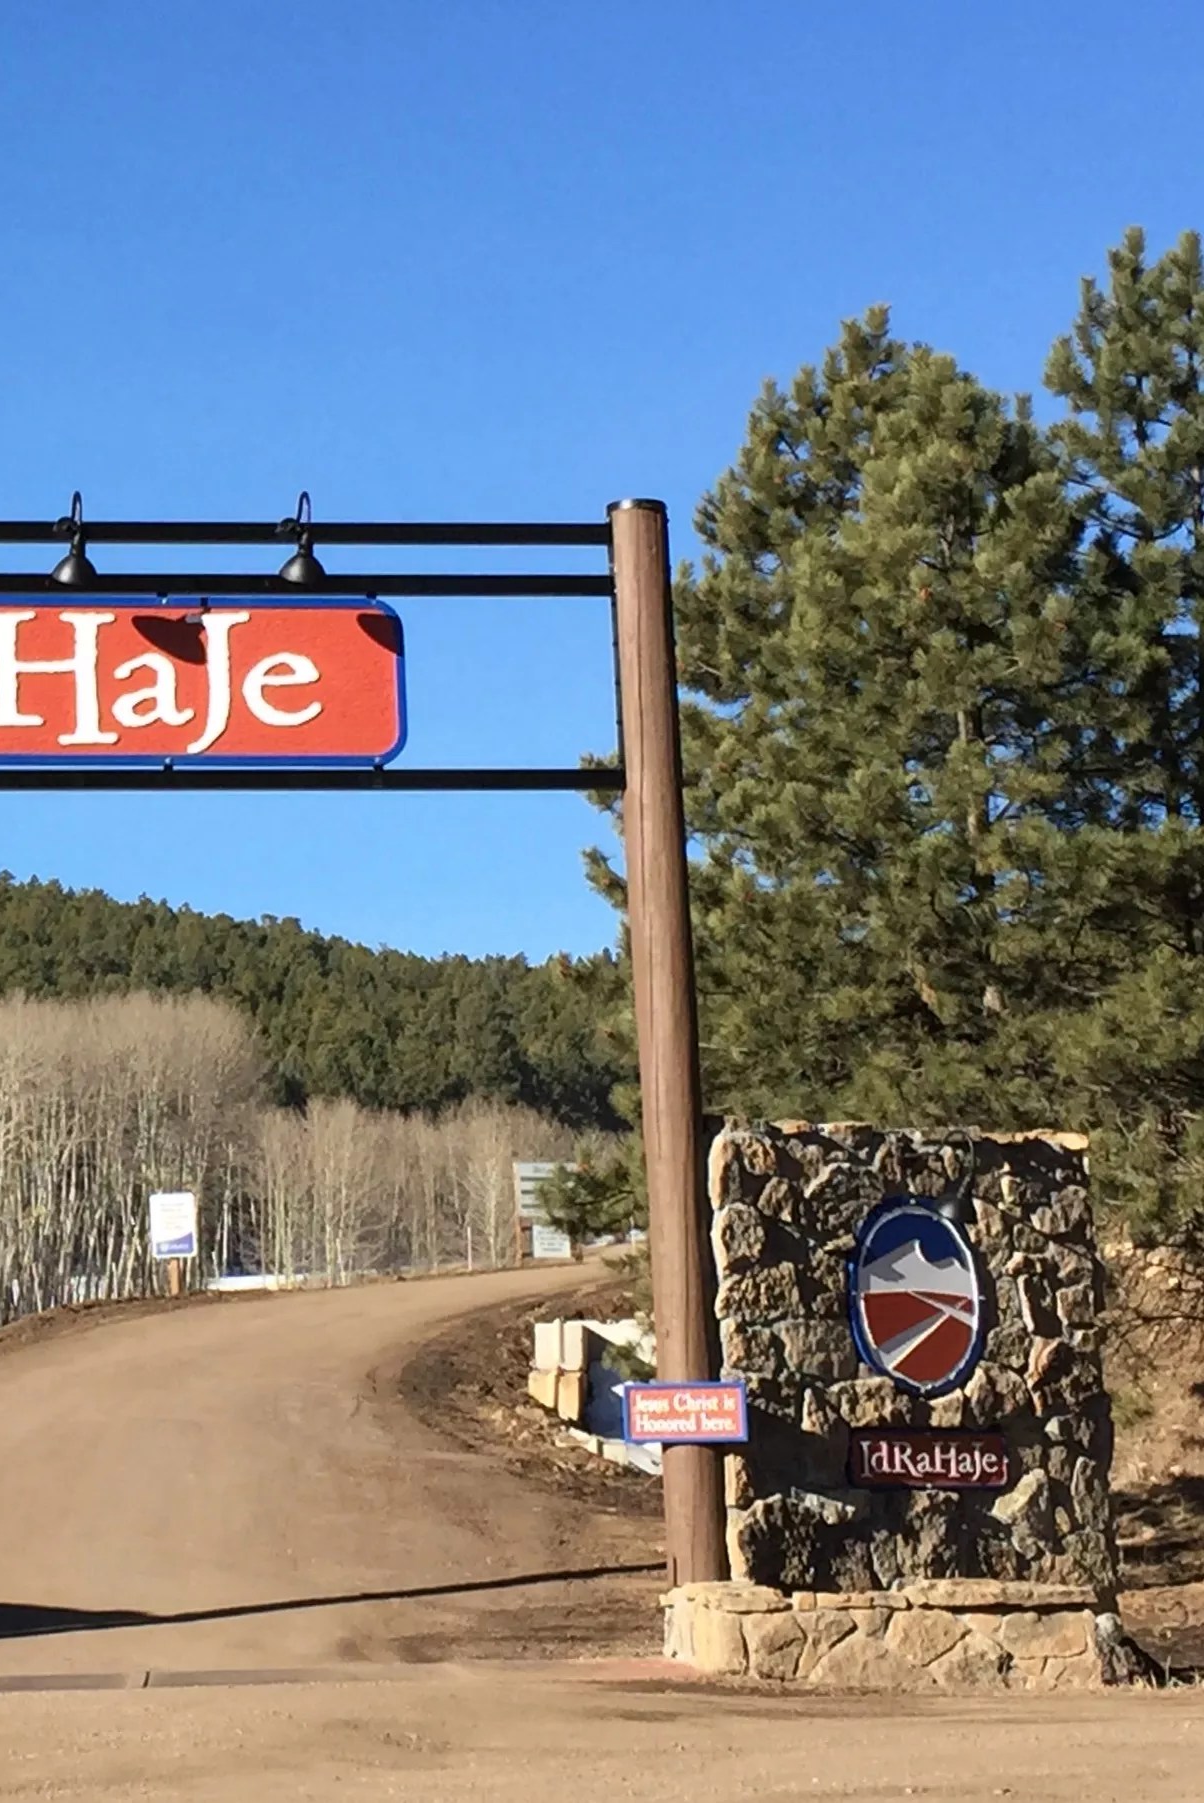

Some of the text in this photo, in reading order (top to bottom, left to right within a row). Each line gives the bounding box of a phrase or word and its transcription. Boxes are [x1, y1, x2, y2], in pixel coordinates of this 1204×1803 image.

[634, 1392, 735, 1413] Jesus Christ is
[635, 1413, 697, 1432] Honored
[859, 1440, 999, 1482] IdRaHaJe
